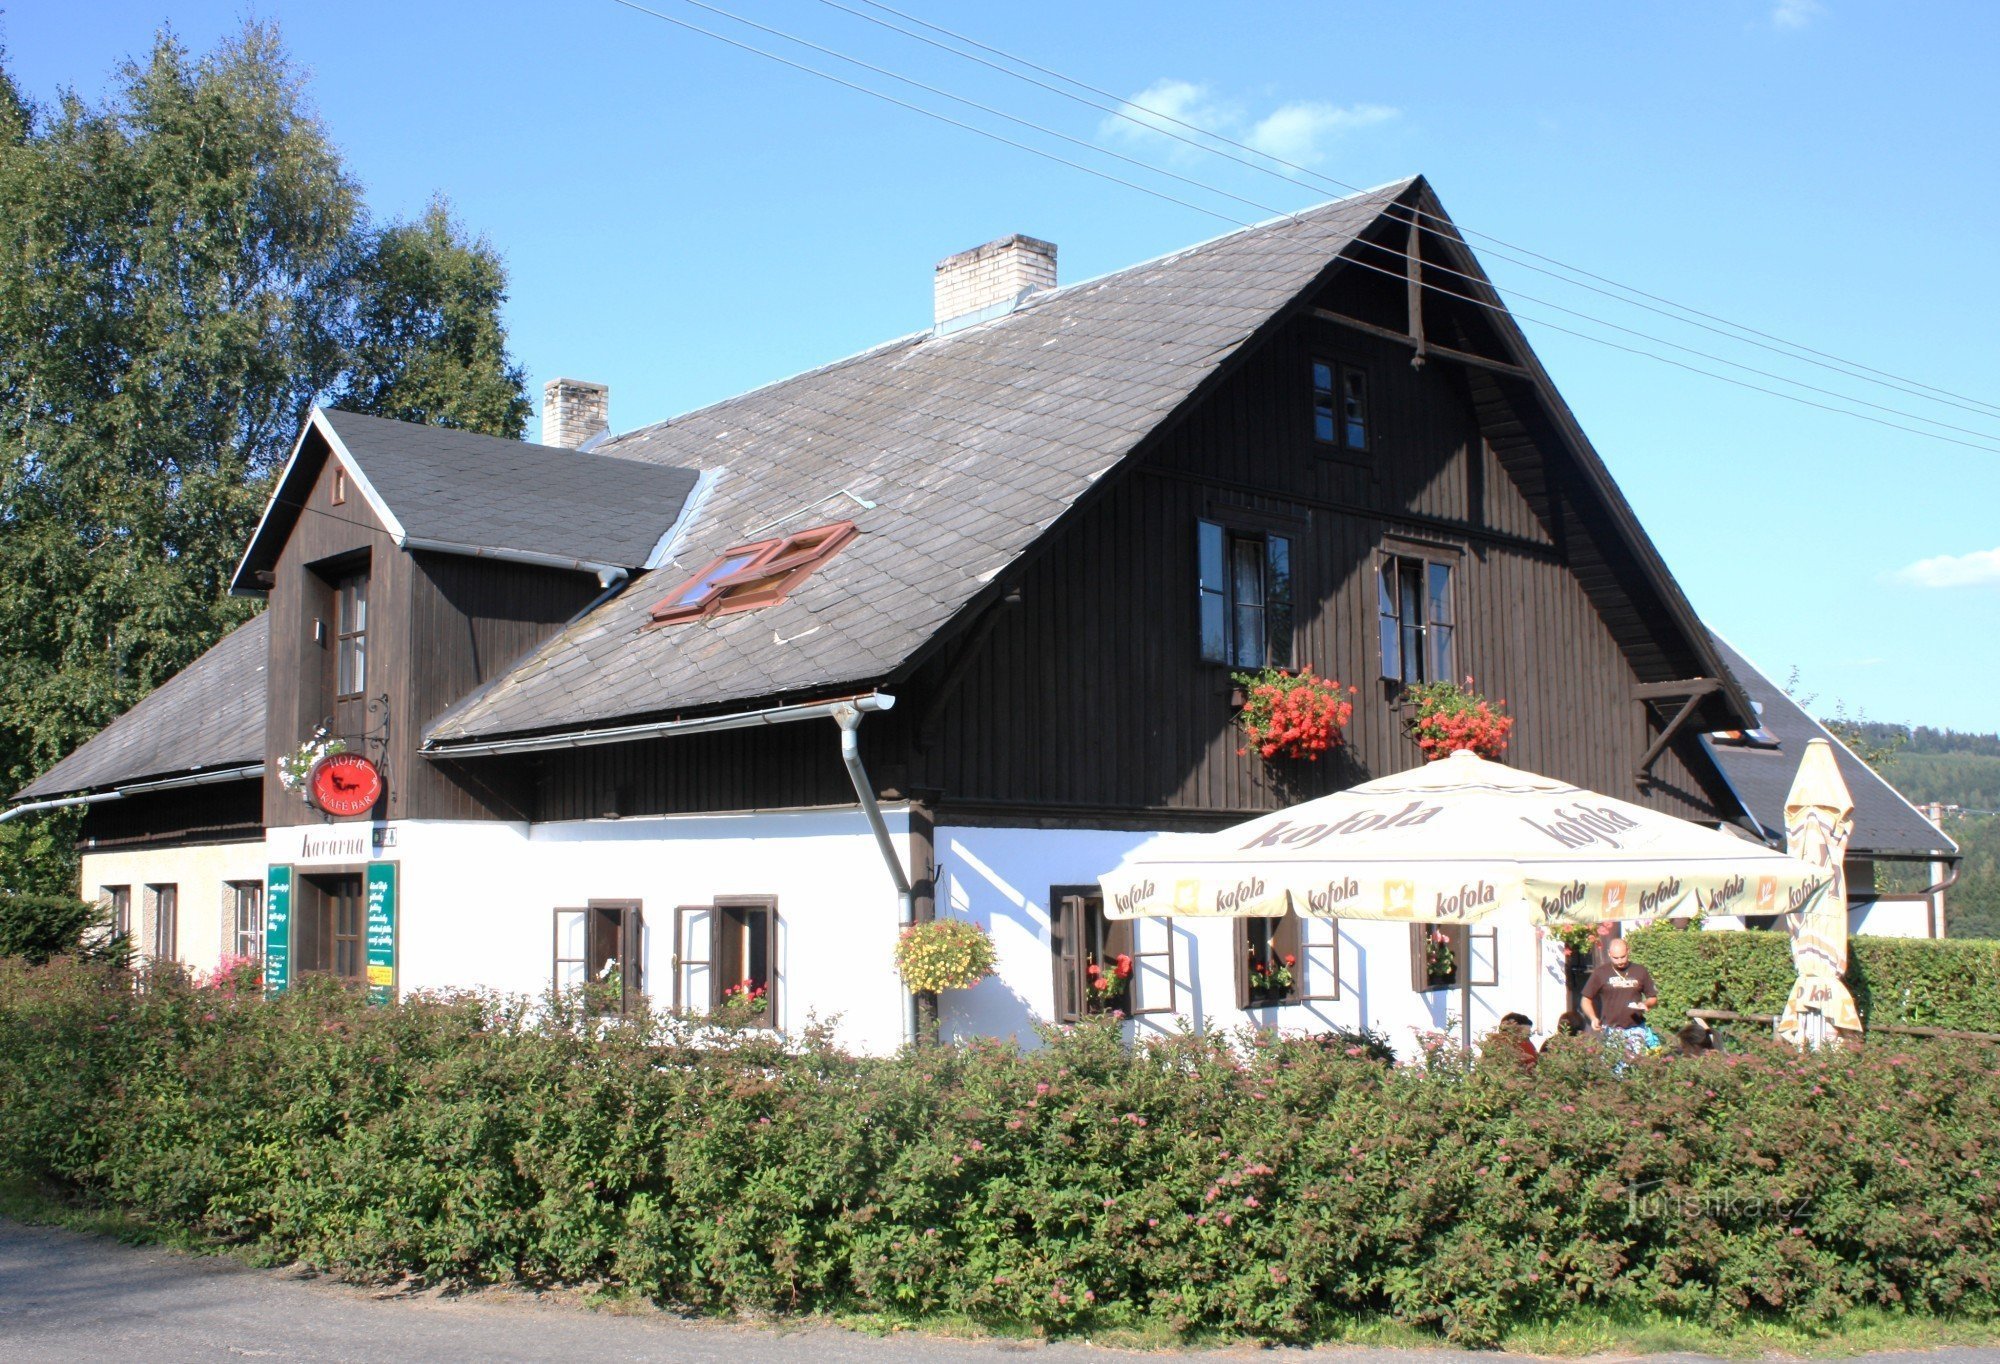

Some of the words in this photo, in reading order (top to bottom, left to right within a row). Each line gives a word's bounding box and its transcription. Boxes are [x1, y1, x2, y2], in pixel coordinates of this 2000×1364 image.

[351, 795, 372, 810] BAR
[1238, 801, 1444, 850] kofola
[1519, 803, 1639, 849] kofola
[1115, 879, 1155, 914] kofola
[1216, 877, 1265, 913] kofola
[1308, 876, 1359, 913] kofola
[1436, 880, 1496, 919] kofola
[1541, 880, 1586, 920] kofola
[1639, 876, 1681, 914] kofola
[1708, 874, 1745, 911] kofola
